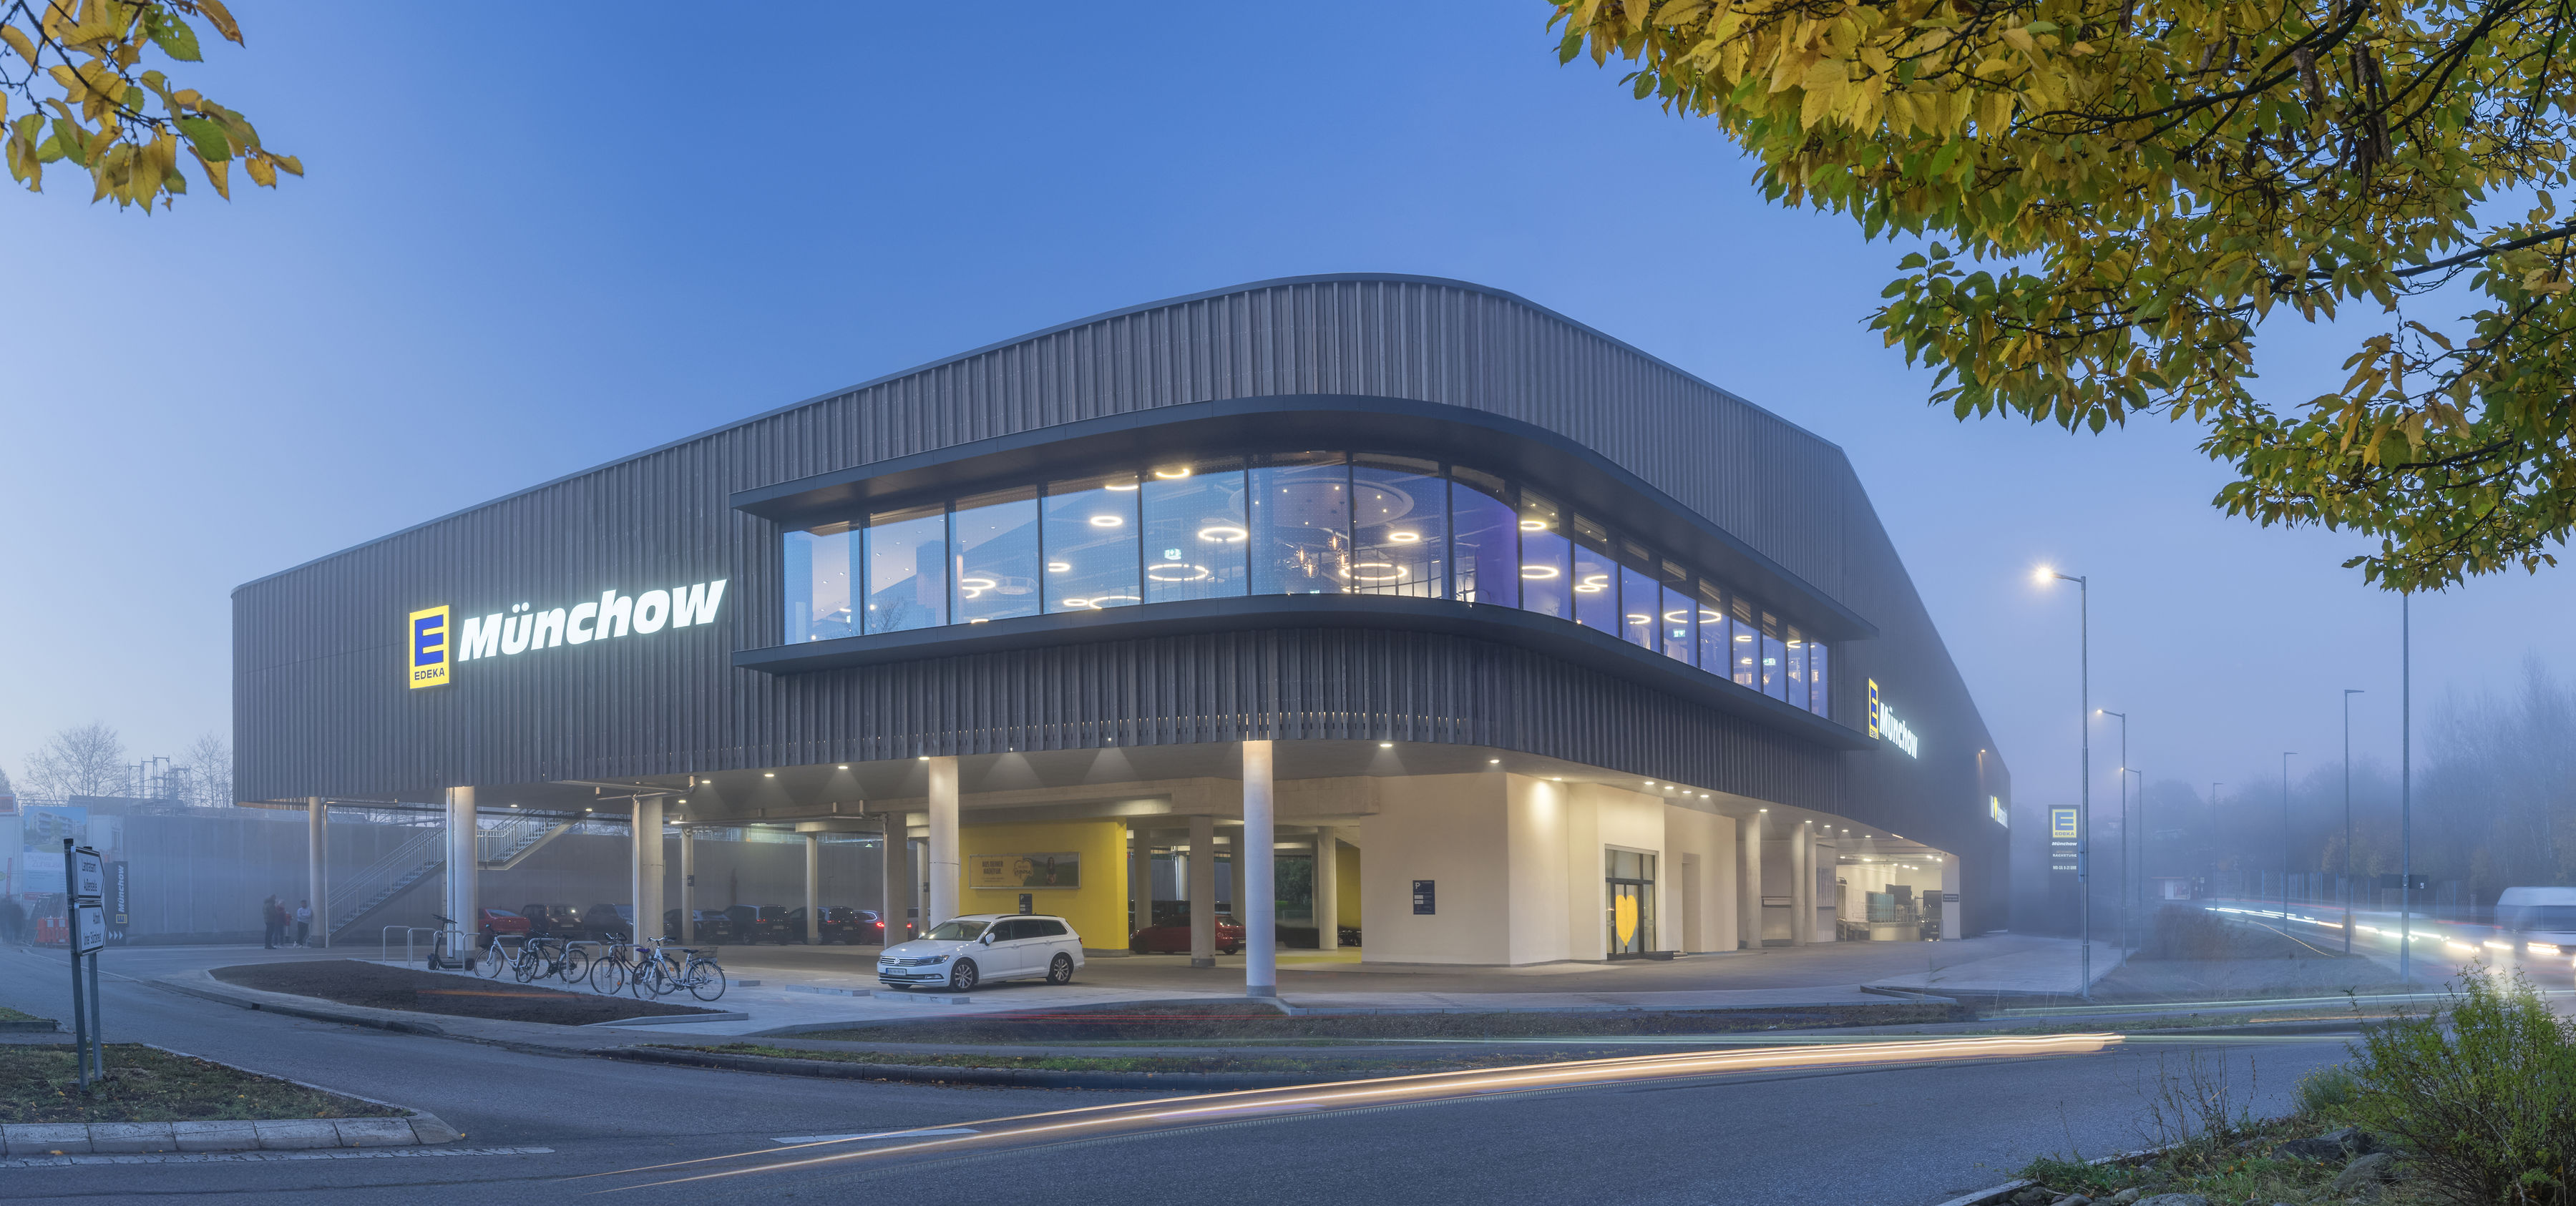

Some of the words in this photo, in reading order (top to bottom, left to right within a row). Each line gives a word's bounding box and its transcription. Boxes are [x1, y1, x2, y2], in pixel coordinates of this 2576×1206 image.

[458, 579, 727, 662] Münchow
[414, 667, 445, 681] EDEKA
[1879, 701, 1918, 760] Münchow
